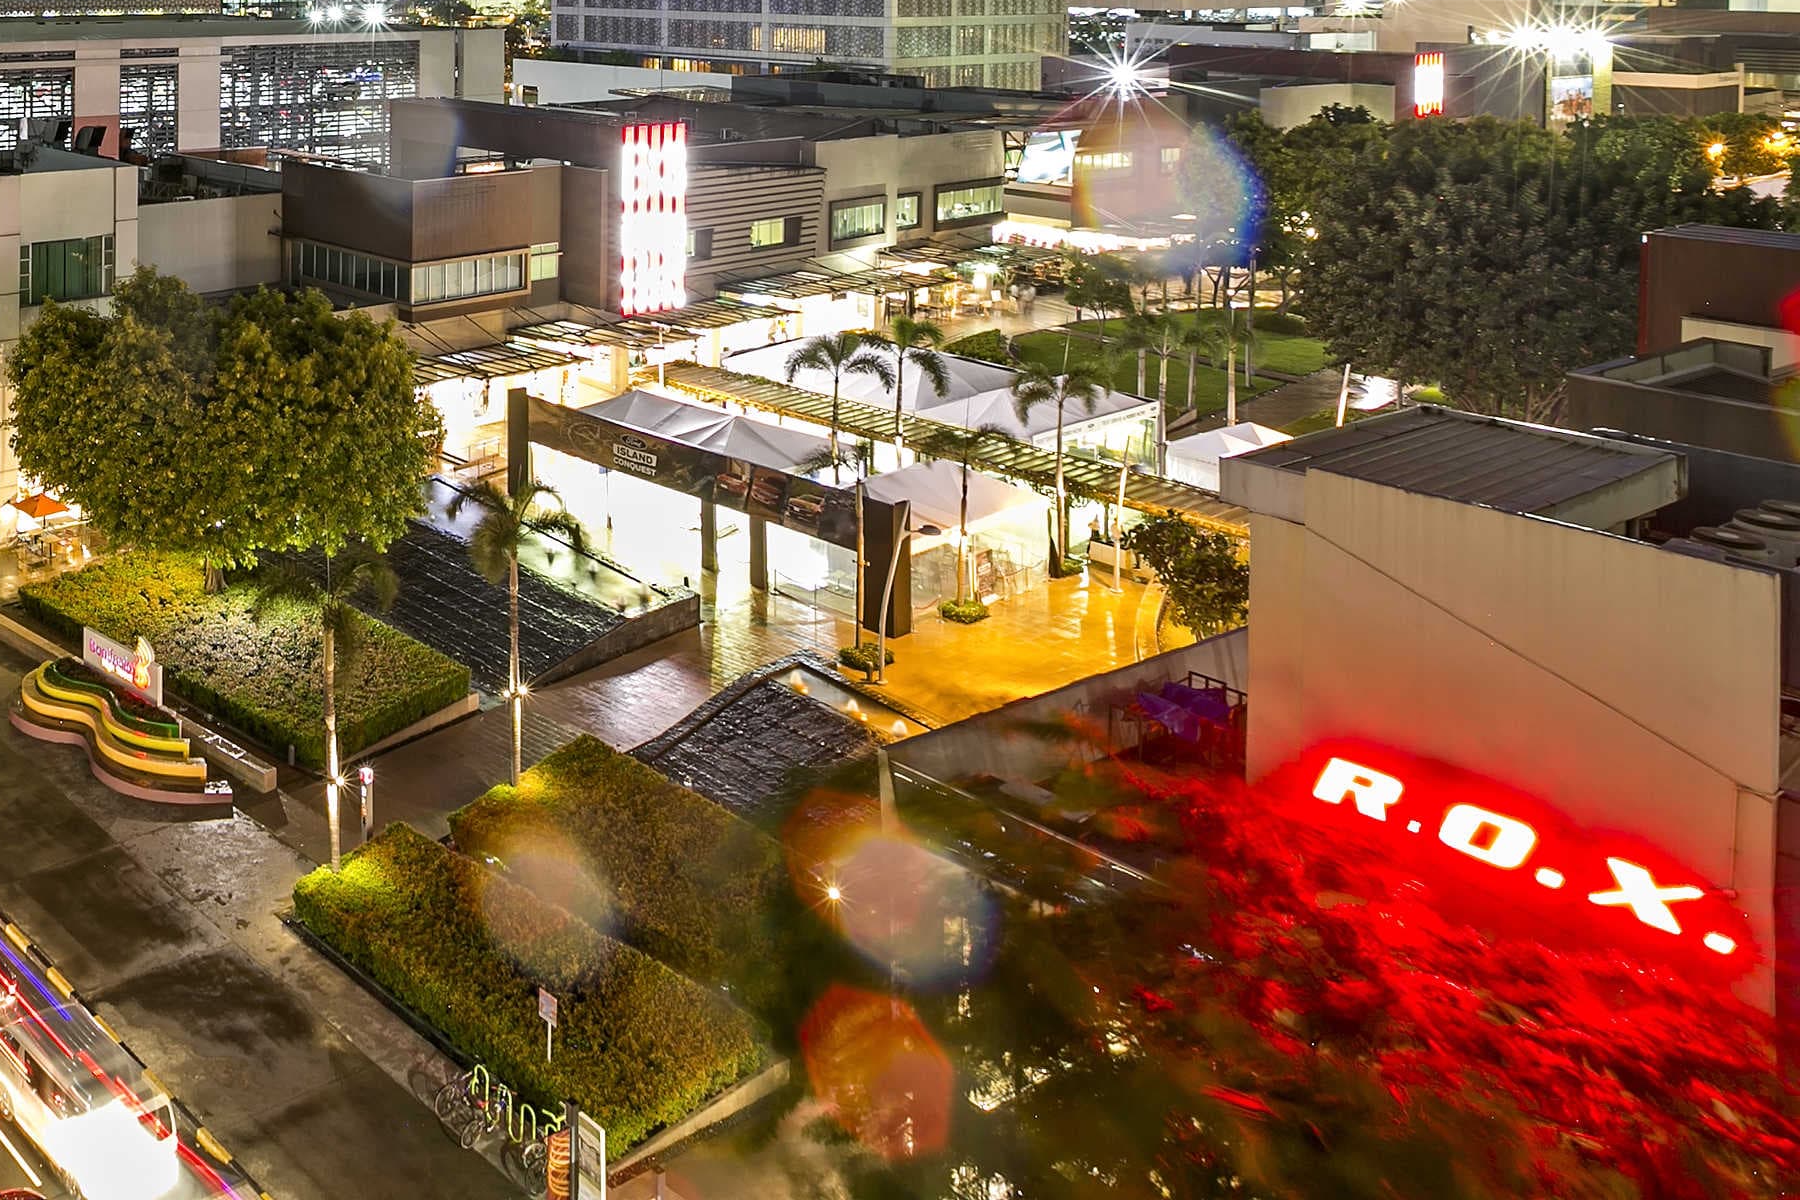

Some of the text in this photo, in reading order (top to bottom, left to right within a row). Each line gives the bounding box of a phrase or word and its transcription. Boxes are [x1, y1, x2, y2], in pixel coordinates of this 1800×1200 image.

[616, 445, 654, 465] ISLAND
[613, 456, 657, 477] CONQUEST
[1313, 771, 1736, 954] R.O.X.
